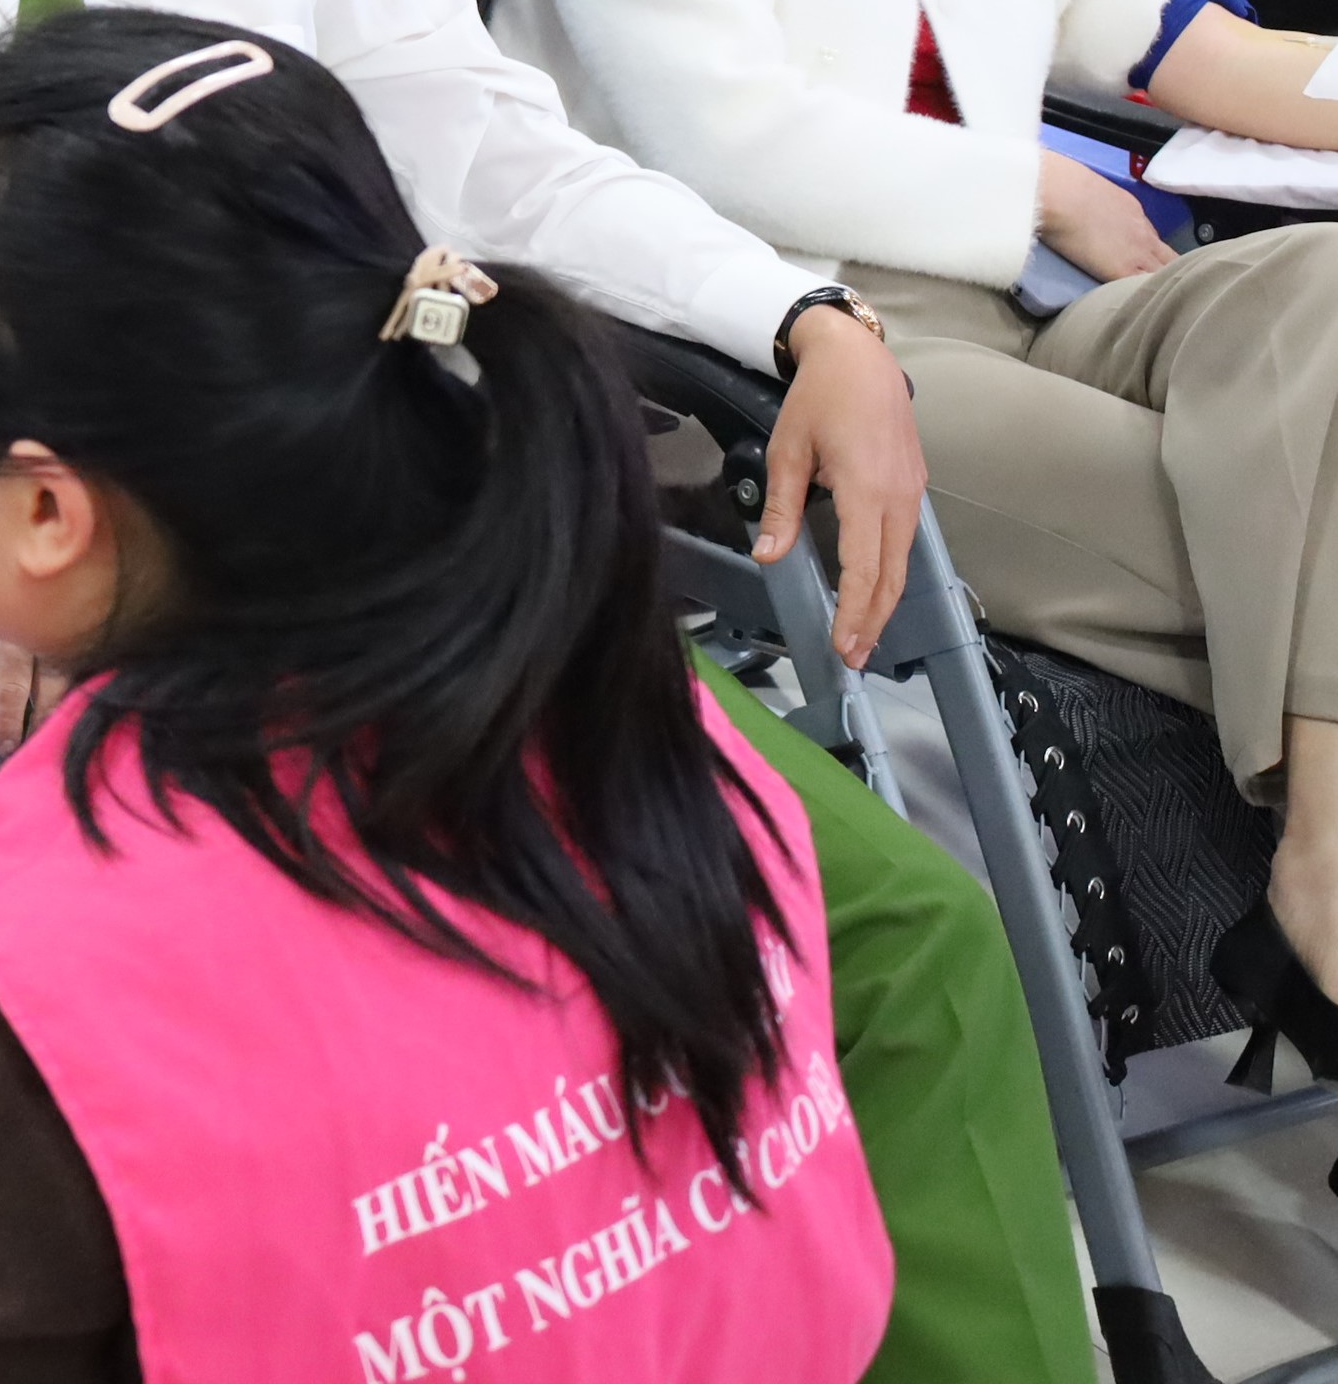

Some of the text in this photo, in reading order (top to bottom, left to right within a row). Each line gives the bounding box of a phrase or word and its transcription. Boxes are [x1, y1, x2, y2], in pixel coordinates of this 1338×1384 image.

[351, 1122, 511, 1256] HIẾN
[503, 1074, 626, 1188] MÁU
[353, 1285, 512, 1384] MỘT
[513, 1192, 692, 1333] NGHĨA
